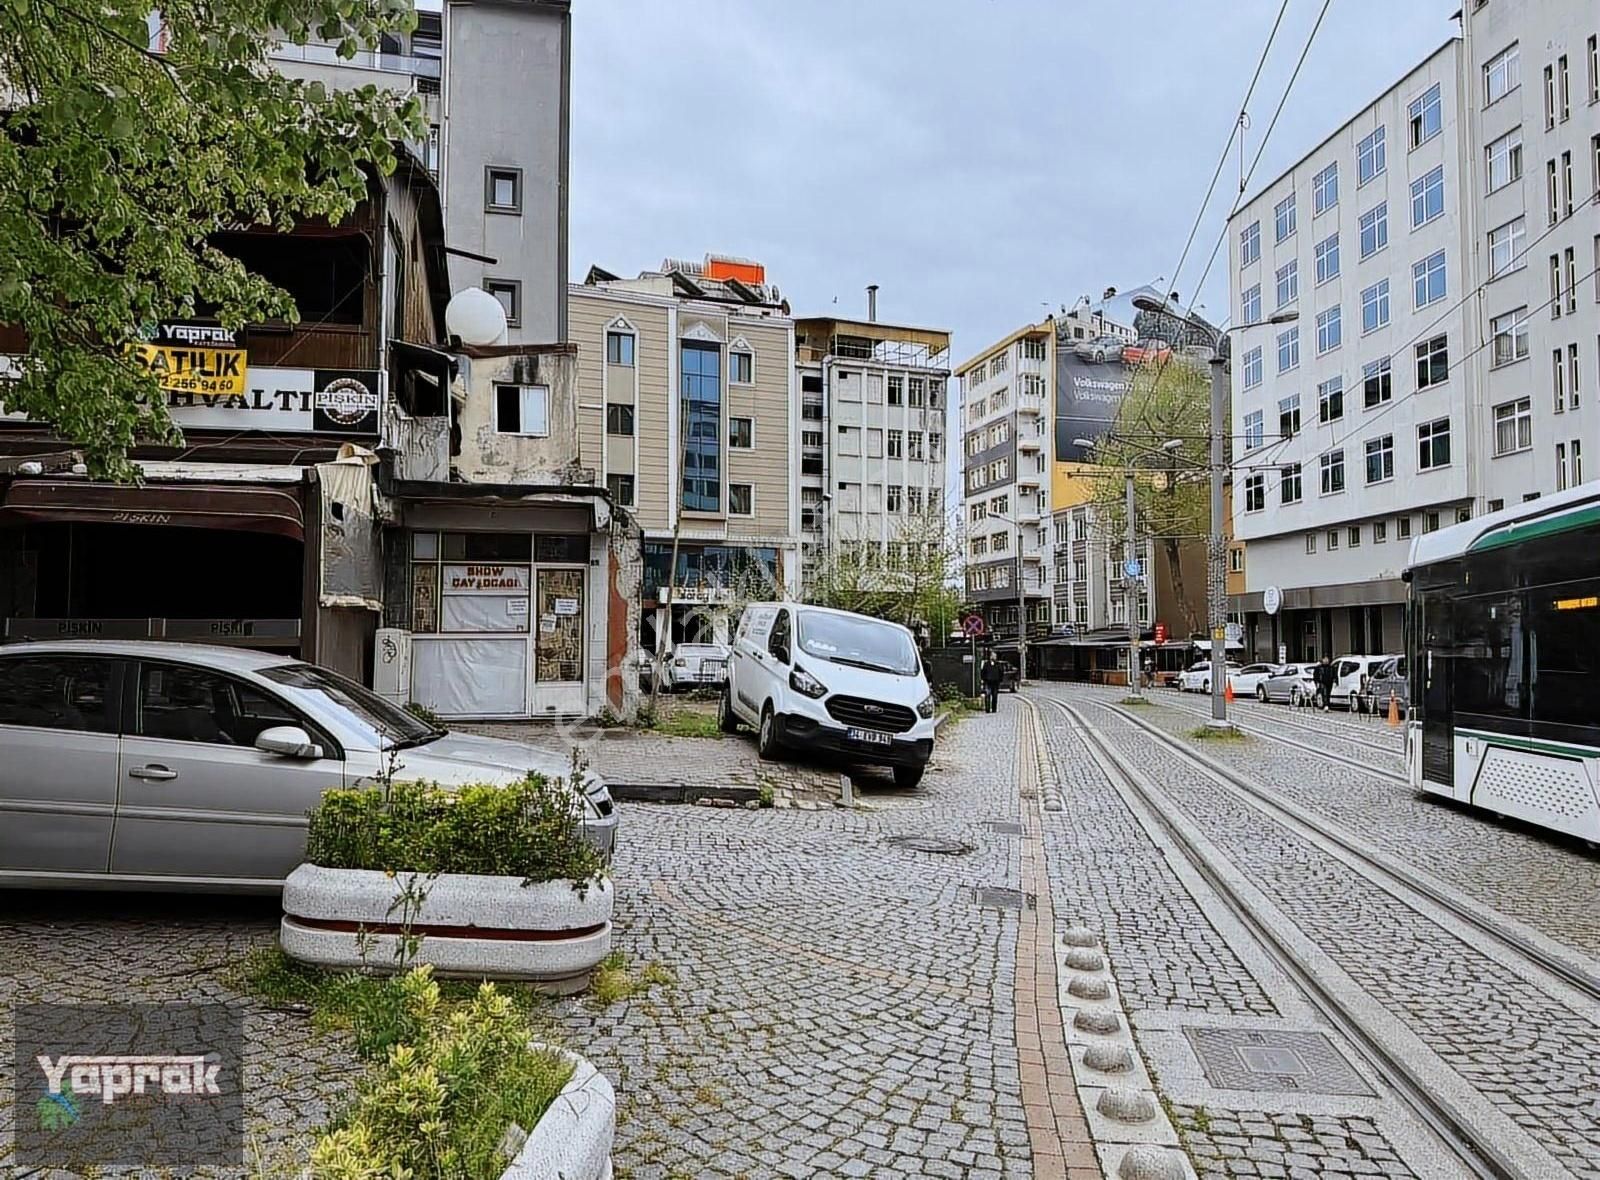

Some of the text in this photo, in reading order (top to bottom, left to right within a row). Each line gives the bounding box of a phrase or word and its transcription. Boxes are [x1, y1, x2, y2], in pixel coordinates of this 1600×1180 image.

[163, 325, 236, 344] Yaprak
[133, 345, 241, 378] SATILIK
[201, 380, 216, 392] 94
[219, 380, 233, 391] 60
[1073, 377, 1124, 391] Volkswagen
[467, 566, 504, 577] SHOW
